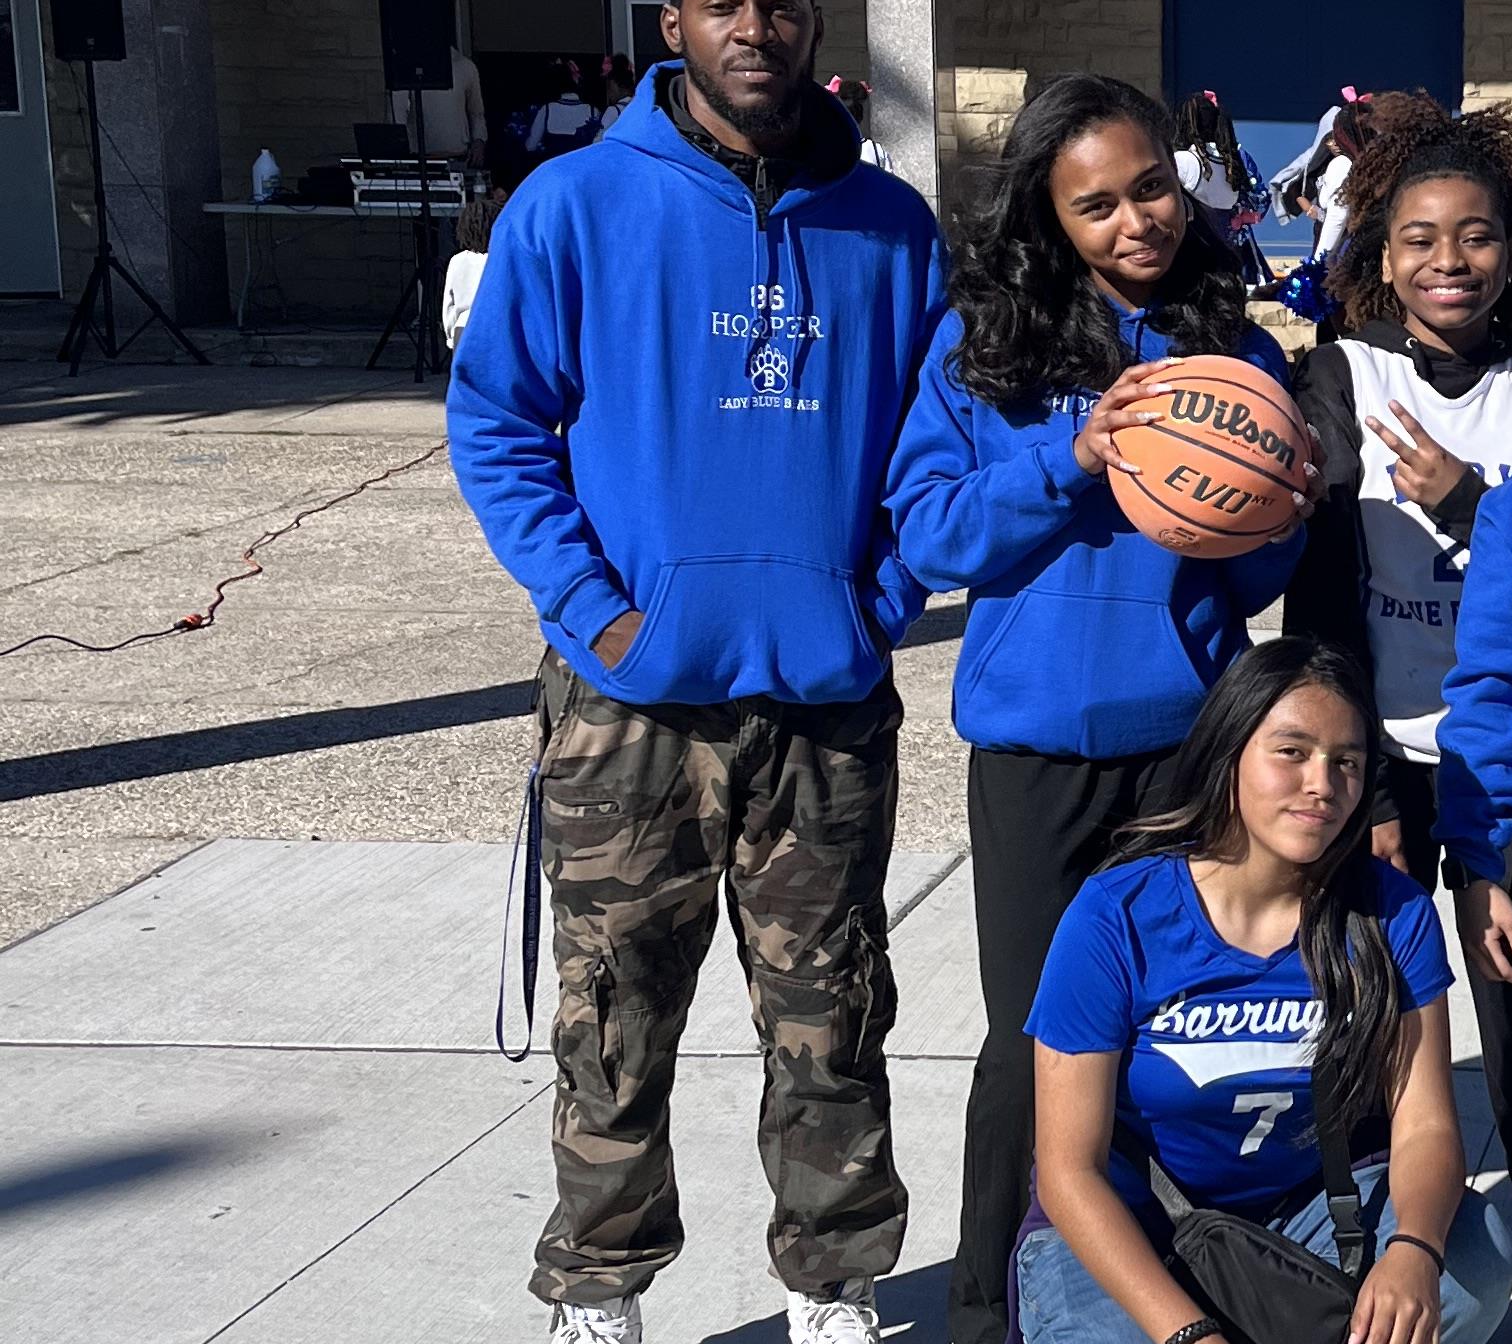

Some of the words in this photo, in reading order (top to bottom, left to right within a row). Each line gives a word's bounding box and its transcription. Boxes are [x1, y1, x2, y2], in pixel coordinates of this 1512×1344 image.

[1170, 389, 1297, 471] Wilson
[1379, 594, 1443, 627] BLUE
[1150, 998, 1326, 1045] Barring
[1232, 1091, 1294, 1157] 7
